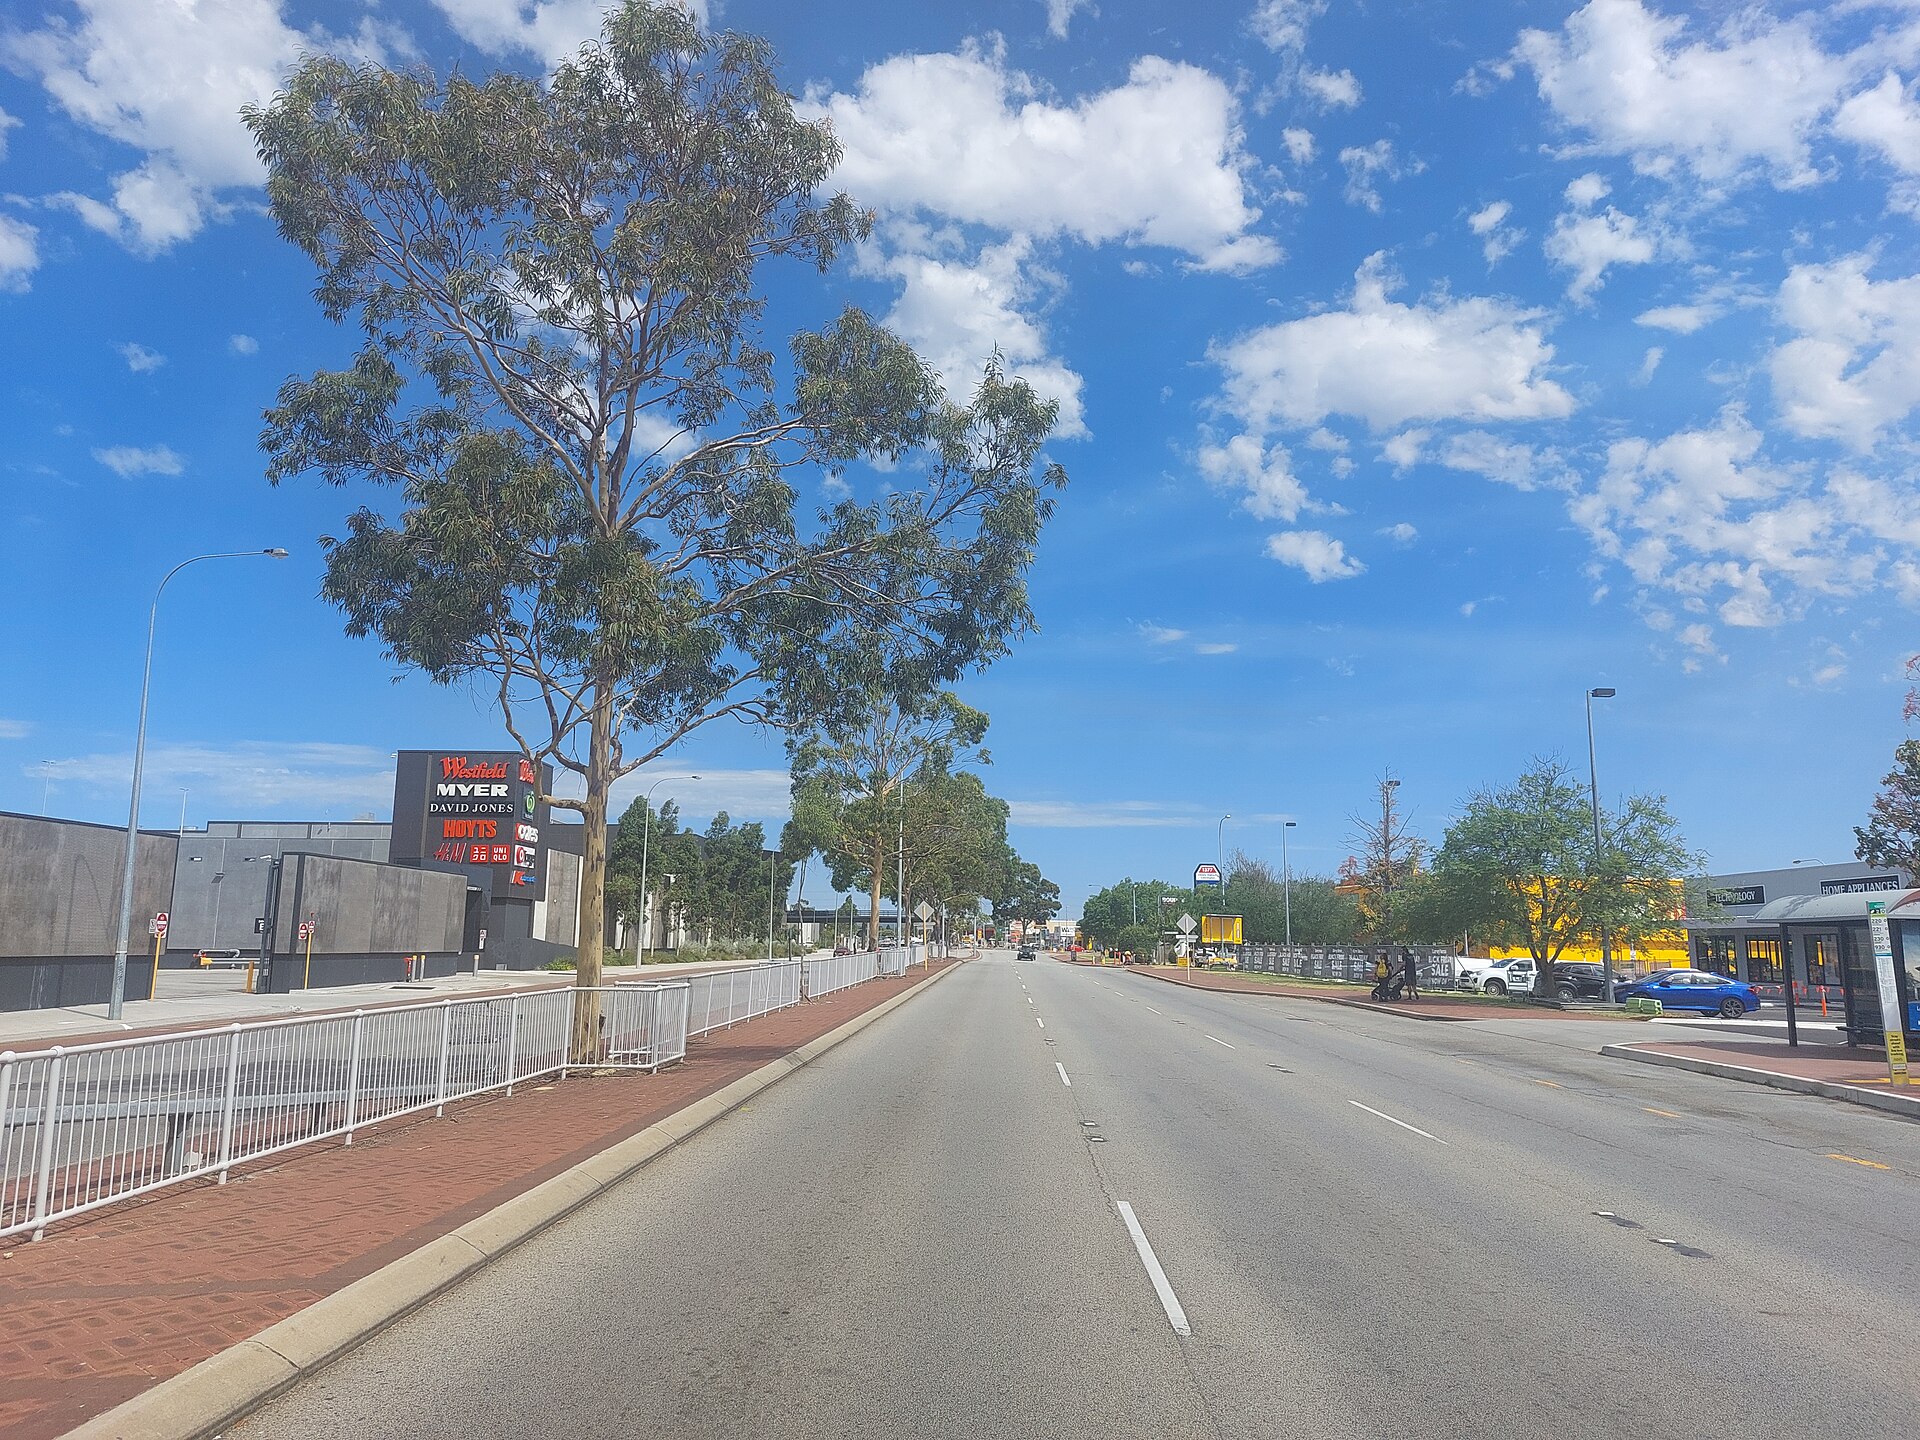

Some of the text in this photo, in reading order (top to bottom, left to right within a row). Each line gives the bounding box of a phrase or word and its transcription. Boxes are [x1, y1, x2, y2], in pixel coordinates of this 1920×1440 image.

[440, 756, 510, 779] Westfield
[436, 783, 509, 797] MYER
[430, 803, 514, 813] DAVID JONES
[443, 818, 498, 838] HOYTS
[433, 842, 468, 864] H&M
[1822, 881, 1898, 895] HOME APPLIANCES
[1431, 963, 1449, 976] SALE
